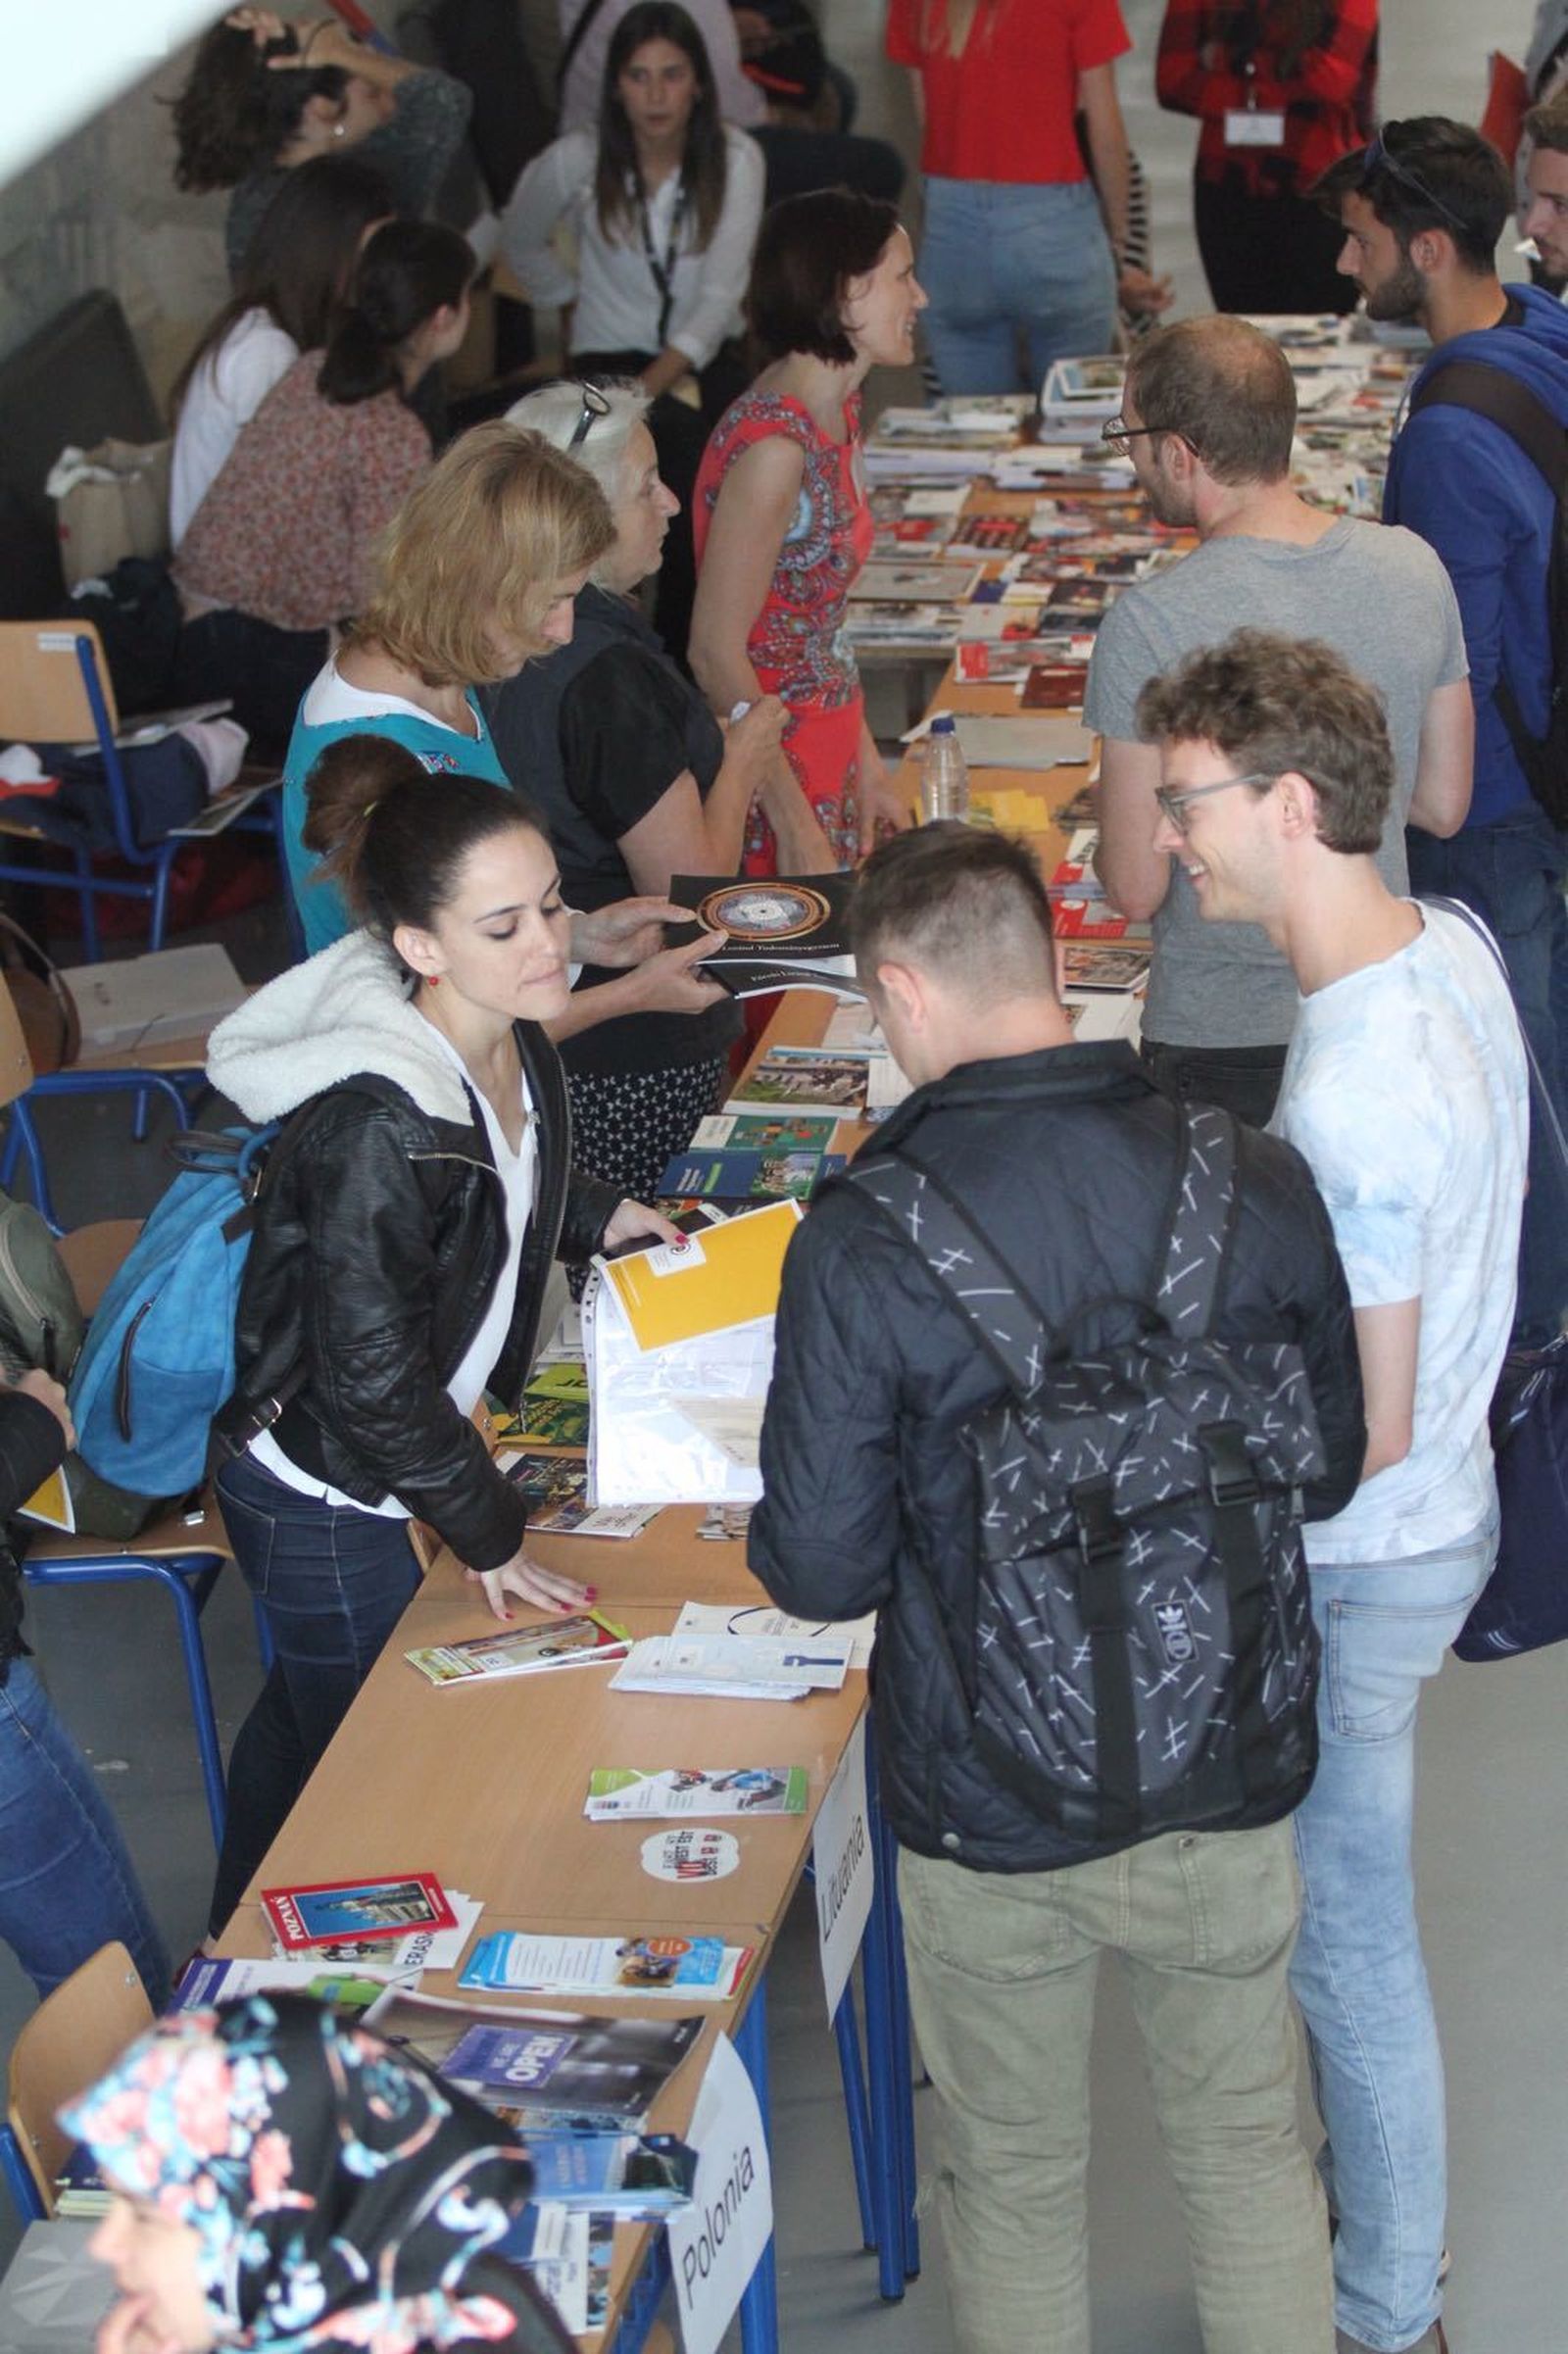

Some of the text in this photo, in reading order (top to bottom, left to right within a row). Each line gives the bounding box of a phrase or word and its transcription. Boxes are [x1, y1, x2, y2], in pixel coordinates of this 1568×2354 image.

[821, 1815, 864, 1942] Lituania
[505, 2035, 565, 2082] OPEN
[682, 2145, 754, 2311] Polonia
